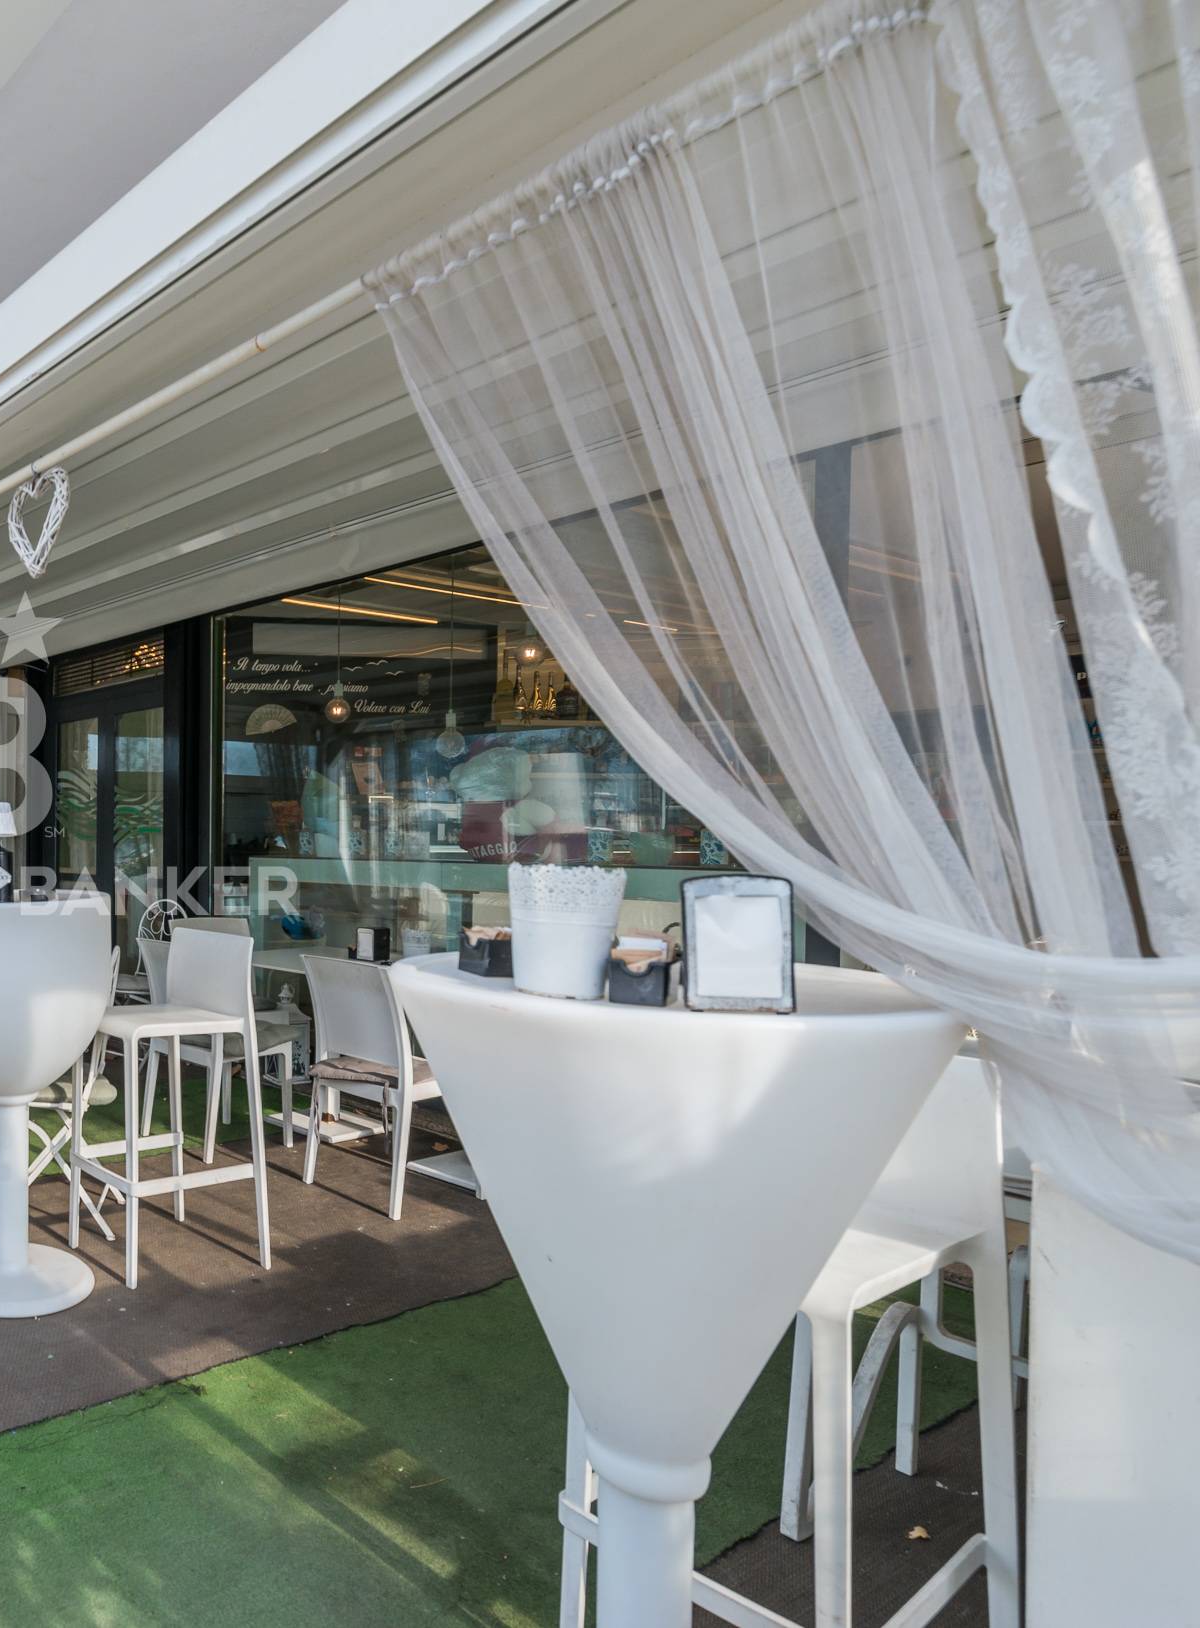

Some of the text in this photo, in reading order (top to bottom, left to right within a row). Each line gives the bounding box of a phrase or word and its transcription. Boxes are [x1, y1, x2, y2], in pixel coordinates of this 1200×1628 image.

[252, 659, 280, 675] tempo
[354, 699, 431, 714] Volare con Lui
